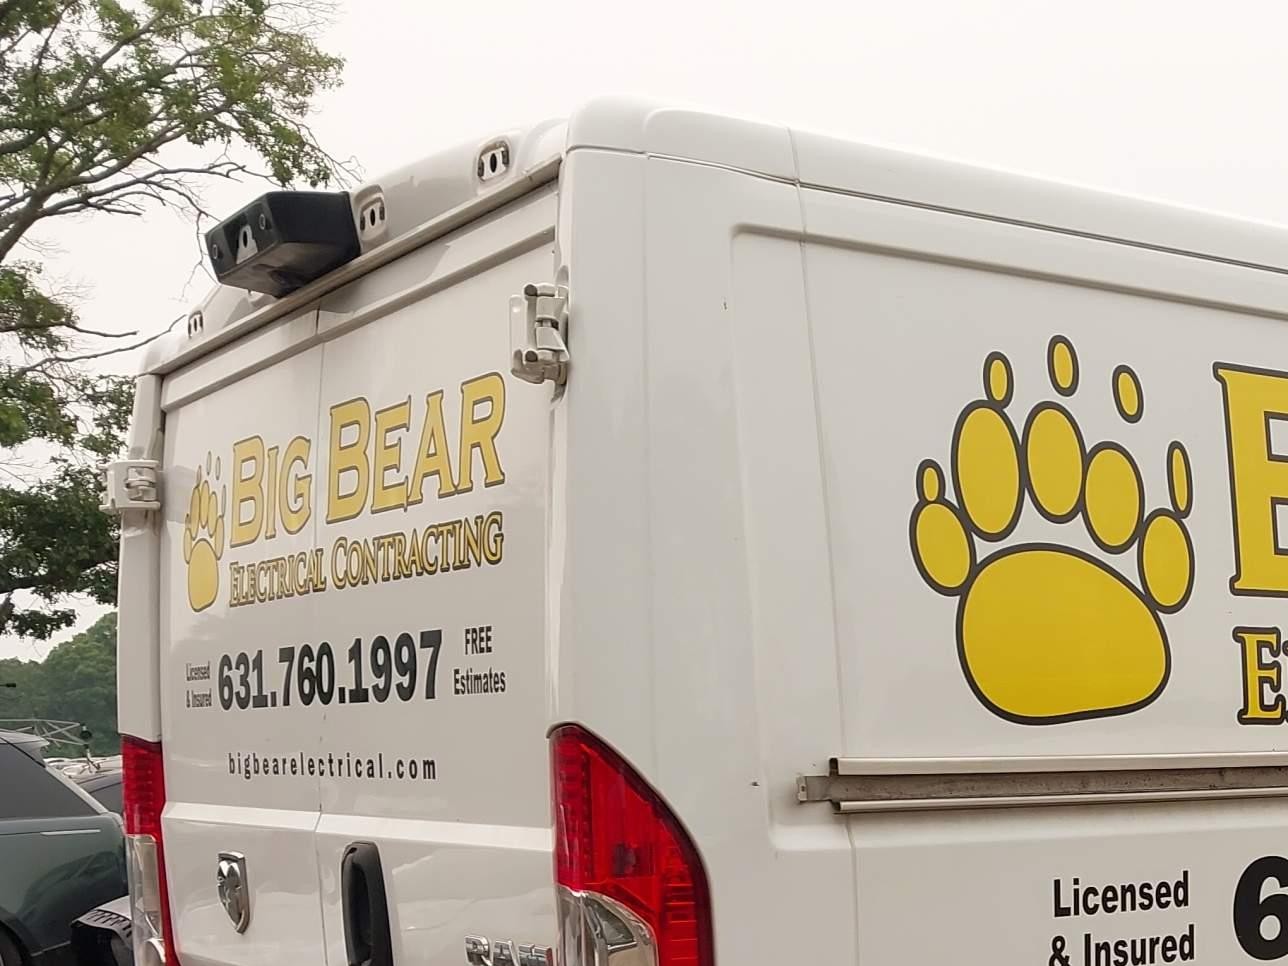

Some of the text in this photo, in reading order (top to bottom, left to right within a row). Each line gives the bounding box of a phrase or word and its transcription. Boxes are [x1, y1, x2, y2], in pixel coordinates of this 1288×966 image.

[229, 371, 506, 548] BIG BEAR
[229, 511, 504, 608] ELECTRICAL CONTRACTING
[465, 625, 493, 655] FREE
[218, 629, 443, 711] 631.760.1997
[453, 667, 506, 696] Estimates
[228, 752, 437, 780] bigbearelectrical.com
[1053, 870, 1189, 917] Licensed
